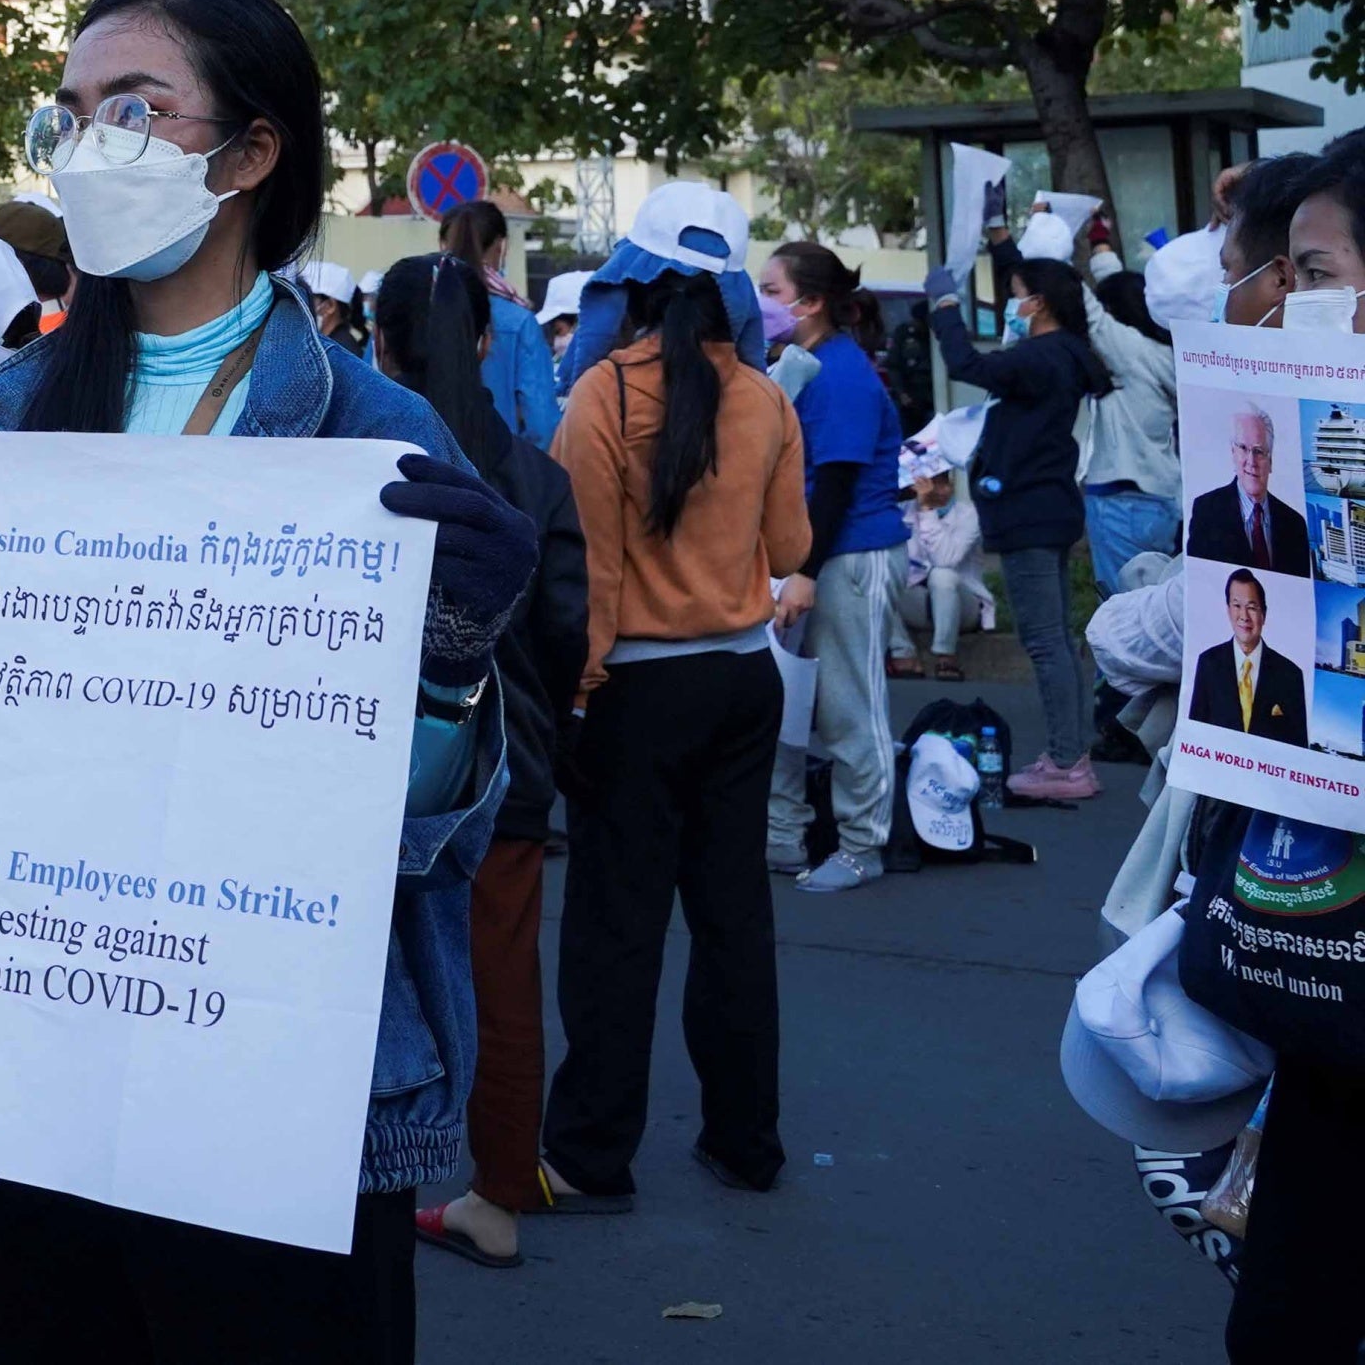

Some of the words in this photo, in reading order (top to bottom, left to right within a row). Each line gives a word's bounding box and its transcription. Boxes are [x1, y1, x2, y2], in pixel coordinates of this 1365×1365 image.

[54, 529, 188, 562] Cambodia
[83, 676, 216, 710] COVID-19
[1180, 742, 1211, 759] NAGA
[1214, 750, 1254, 770] WORLD
[1257, 762, 1287, 779] MUST
[1289, 770, 1360, 797] REINSTATED
[7, 851, 158, 902] Employees
[168, 880, 206, 907] on
[217, 878, 340, 927] Strike!
[1304, 865, 1330, 881] World
[94, 920, 210, 965] against
[43, 964, 226, 1027] COVID-19
[1240, 963, 1284, 989] need
[1288, 976, 1344, 1002] union
